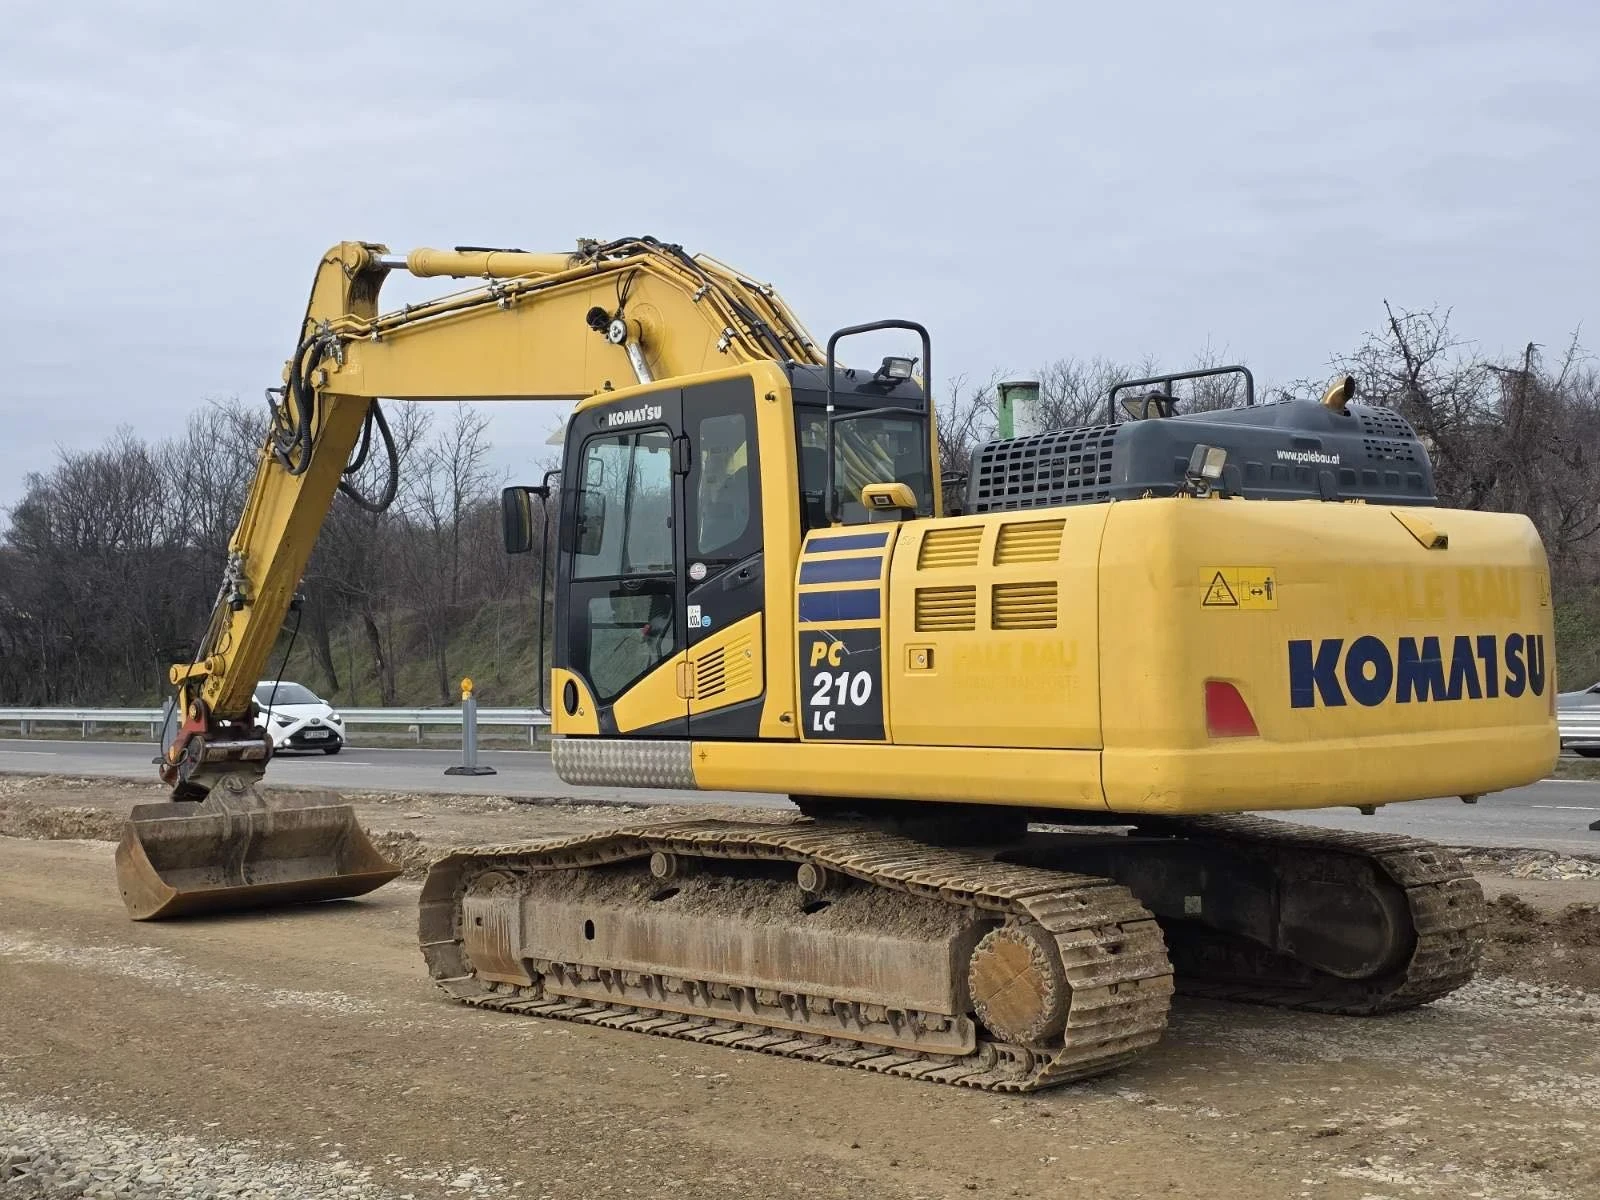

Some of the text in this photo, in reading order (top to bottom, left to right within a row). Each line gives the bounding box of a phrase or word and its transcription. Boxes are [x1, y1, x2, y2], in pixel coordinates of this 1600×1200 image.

[608, 404, 662, 426] KOMATSU
[1276, 449, 1341, 464] www.palebau.at
[809, 640, 843, 668] PC
[1287, 632, 1546, 709] KOMATSU
[809, 670, 872, 706] 210
[813, 710, 836, 732] LC
